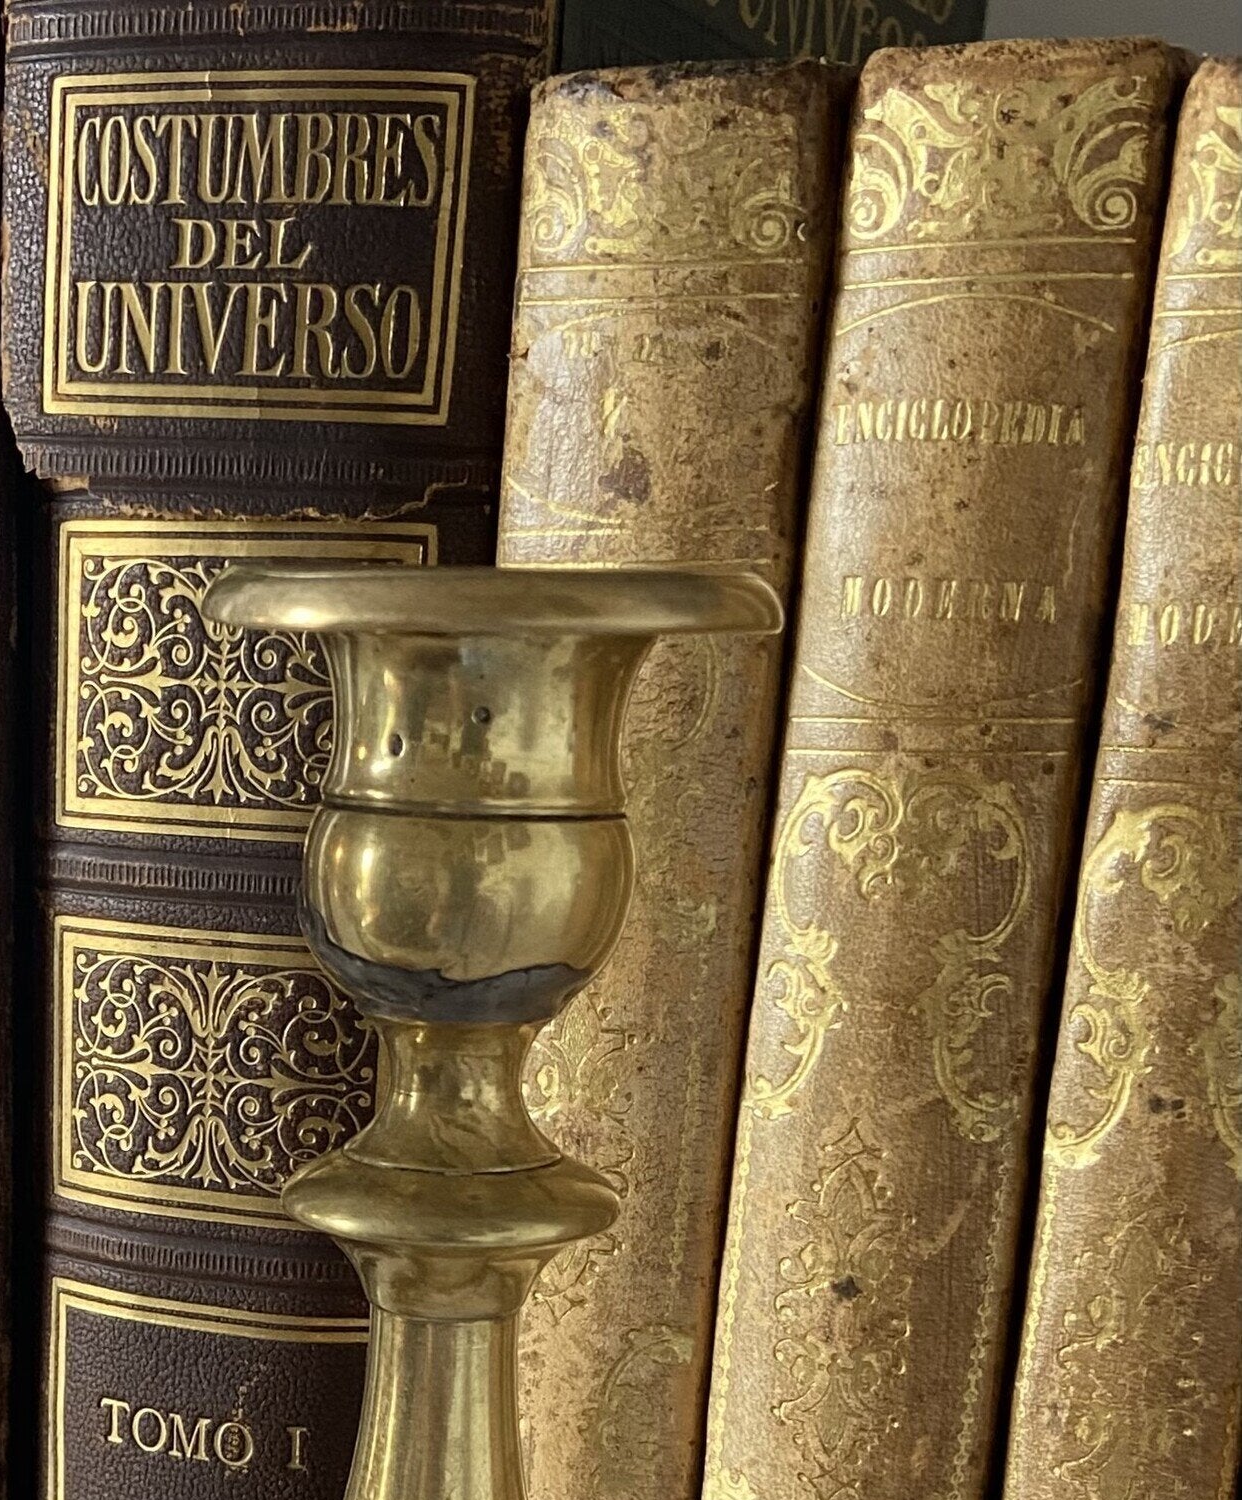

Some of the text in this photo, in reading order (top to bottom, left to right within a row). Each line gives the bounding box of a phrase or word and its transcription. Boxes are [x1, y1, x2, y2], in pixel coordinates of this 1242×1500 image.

[76, 112, 441, 207] COSTUMBRES
[169, 216, 314, 271] DEL
[75, 280, 421, 380] UNIVERSO
[1132, 442, 1242, 488] ENCIC
[100, 1396, 311, 1470] TOMO I
